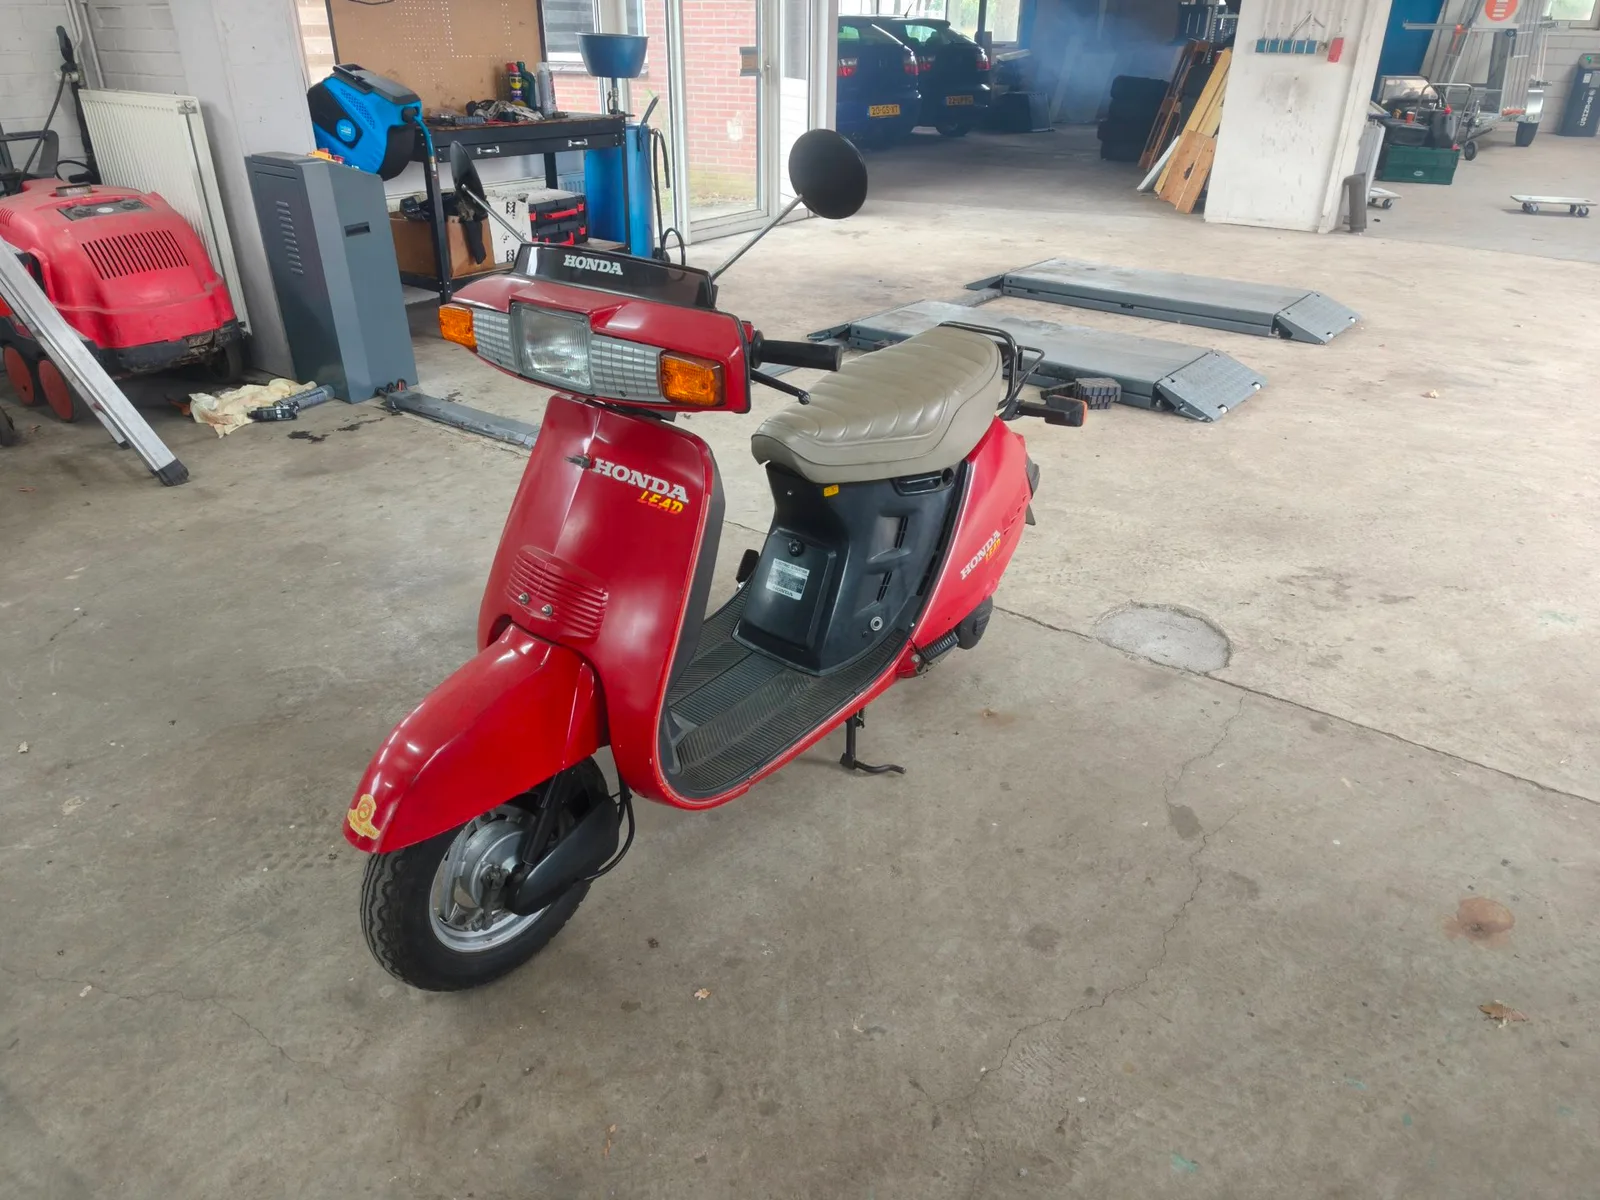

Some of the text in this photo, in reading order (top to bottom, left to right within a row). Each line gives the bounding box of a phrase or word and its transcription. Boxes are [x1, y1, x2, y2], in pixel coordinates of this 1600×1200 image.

[563, 254, 623, 275] HONDA
[592, 457, 690, 503] HONDA
[637, 490, 684, 514] LEAD
[960, 529, 1001, 580] HONDA
